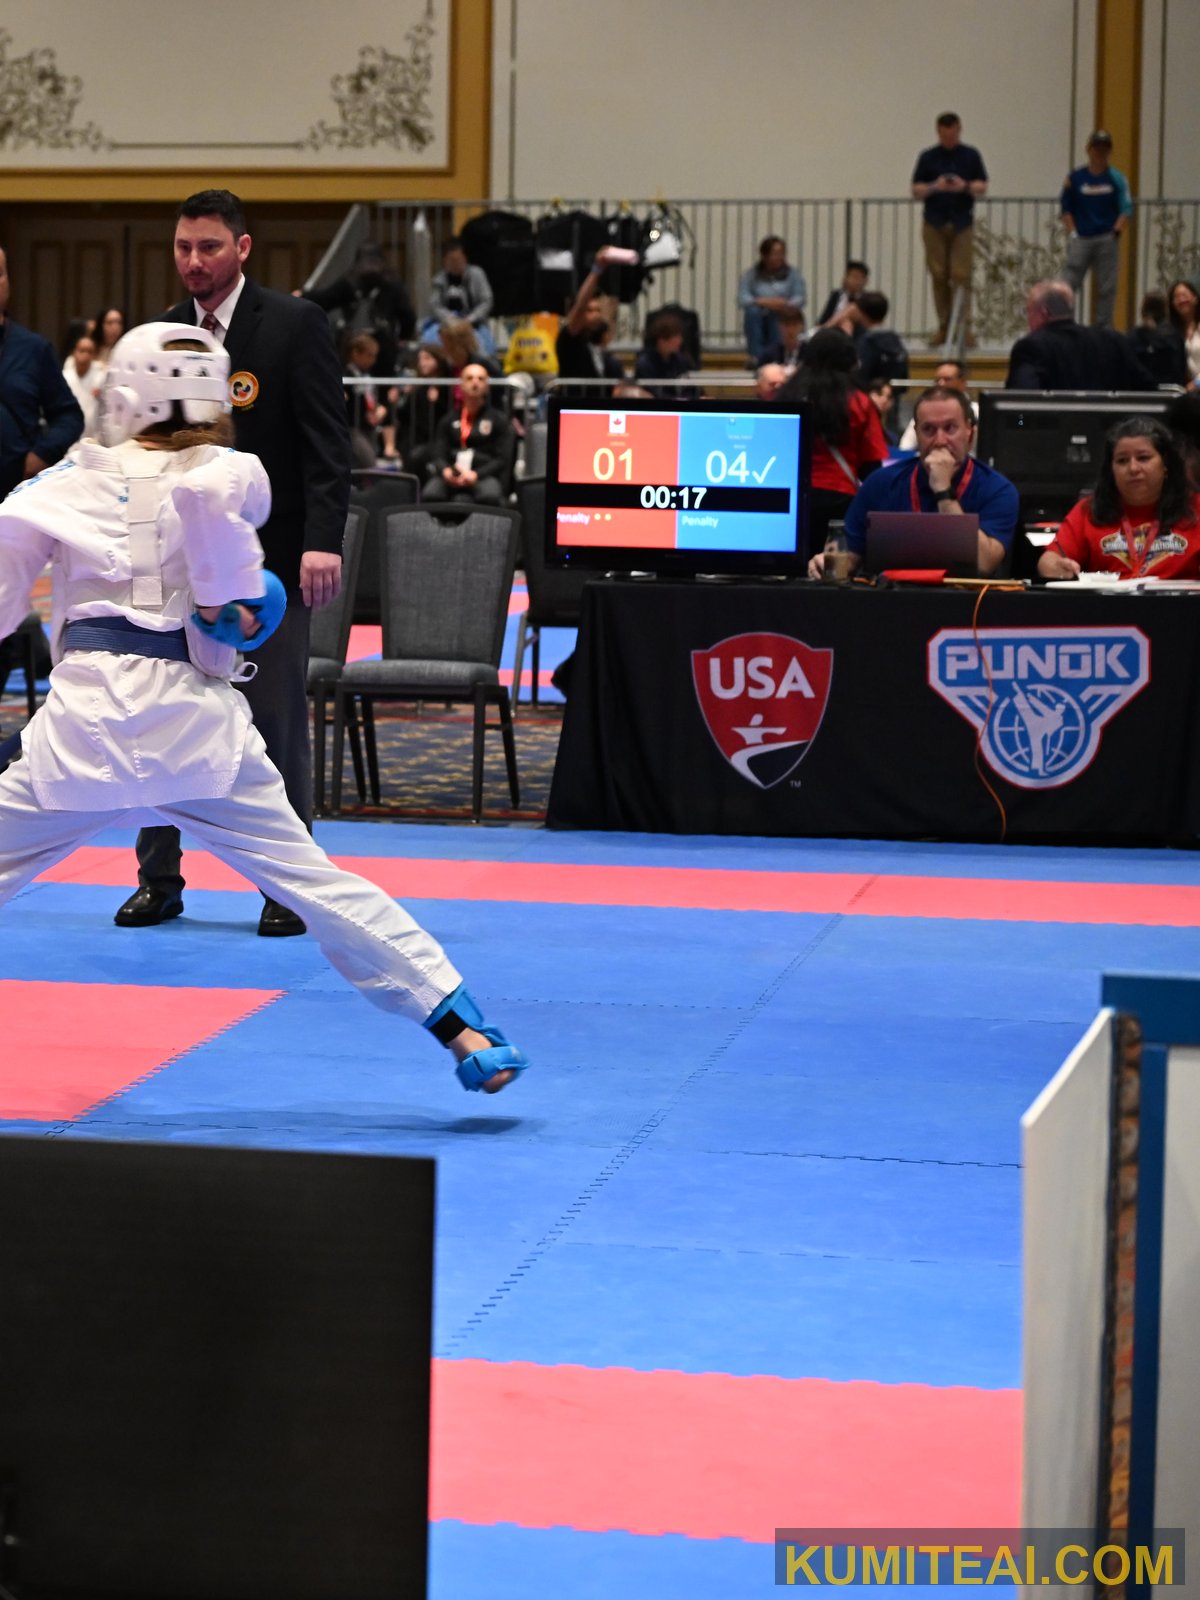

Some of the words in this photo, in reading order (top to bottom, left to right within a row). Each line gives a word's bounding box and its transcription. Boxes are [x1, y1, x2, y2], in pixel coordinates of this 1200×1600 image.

[593, 447, 633, 481] 01
[705, 450, 749, 484] 04
[640, 485, 708, 510] 00:17
[557, 511, 590, 525] enalty
[682, 514, 719, 528] Penalty
[709, 656, 816, 700] USA
[945, 643, 1131, 681] PUNOK
